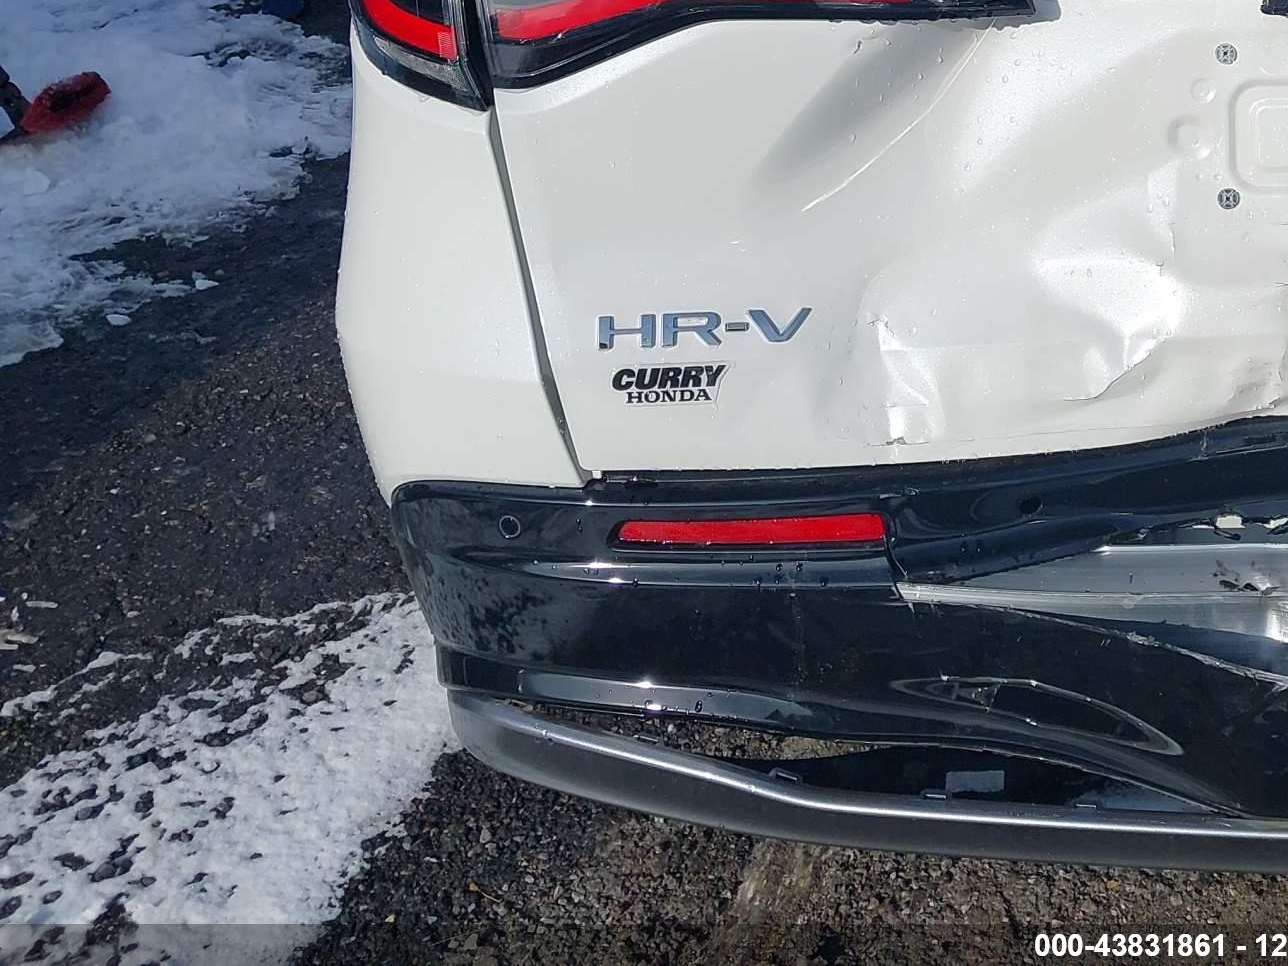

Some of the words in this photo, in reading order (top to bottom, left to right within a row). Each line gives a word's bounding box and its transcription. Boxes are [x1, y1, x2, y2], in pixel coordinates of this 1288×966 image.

[597, 306, 813, 350] HR-V
[611, 364, 727, 391] CURRY
[625, 389, 712, 404] HONDA
